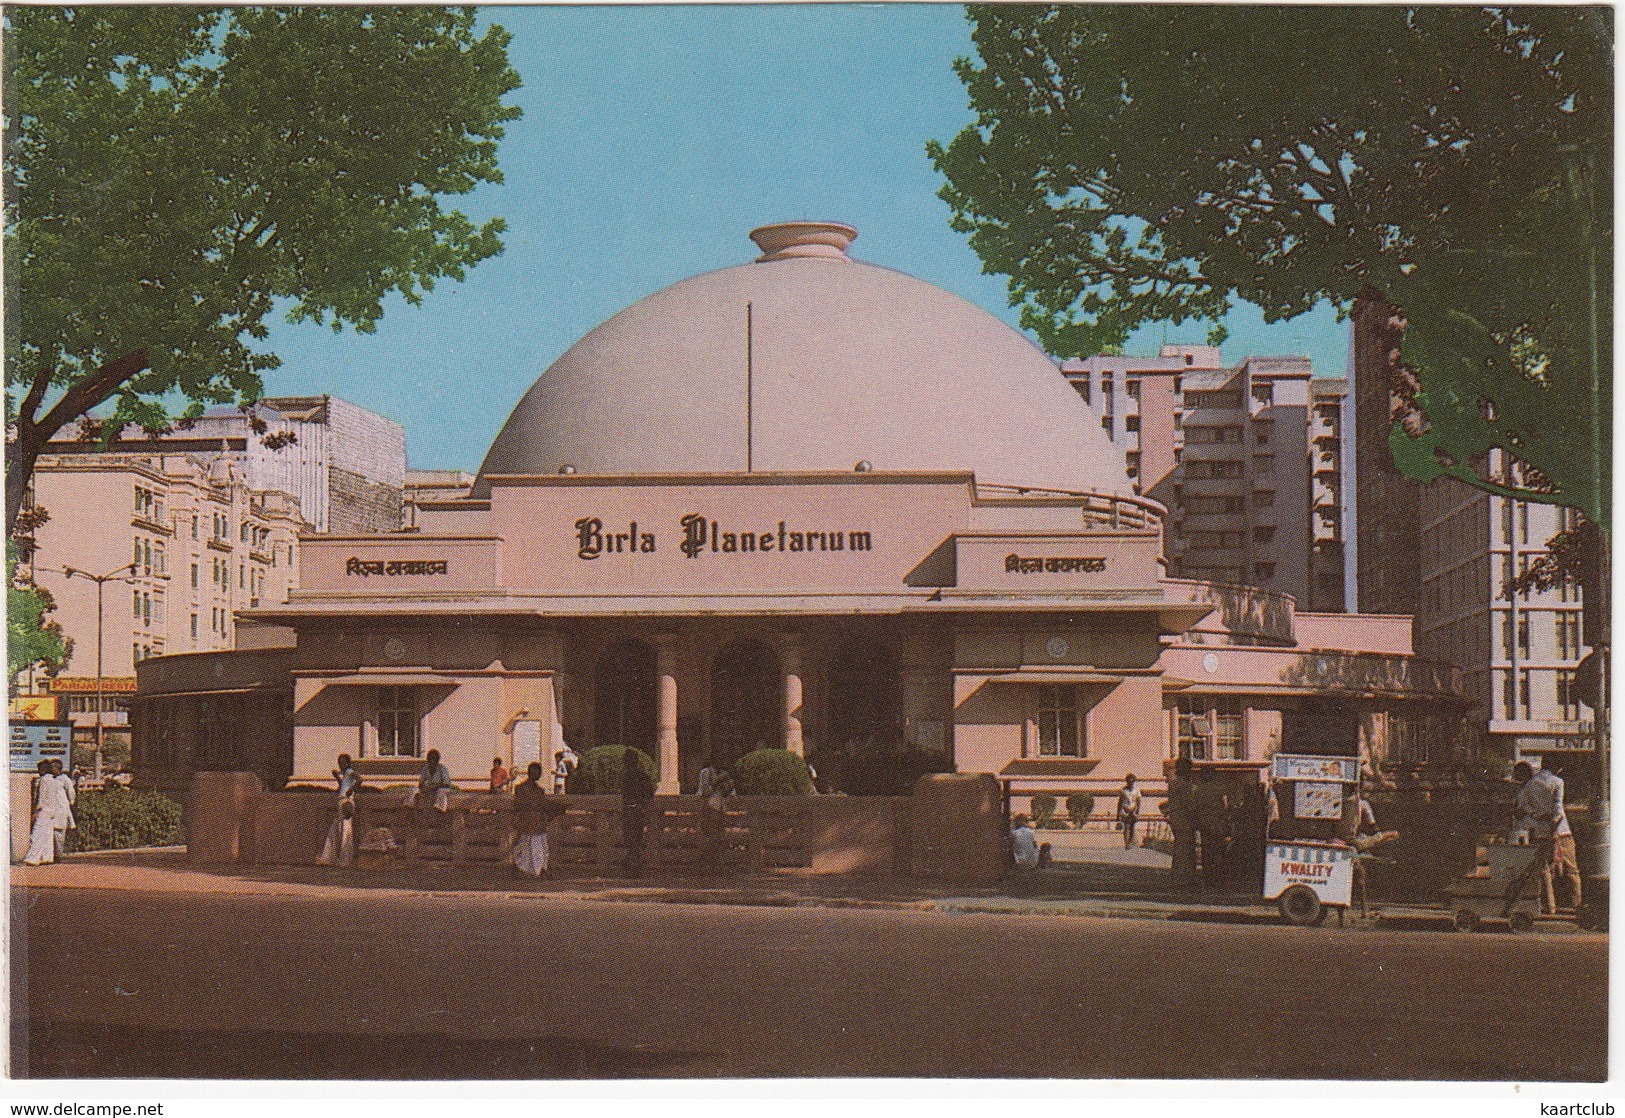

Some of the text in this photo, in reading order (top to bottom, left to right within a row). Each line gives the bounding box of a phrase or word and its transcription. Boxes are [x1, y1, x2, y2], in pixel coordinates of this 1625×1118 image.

[574, 512, 873, 561] Birla Planetarium
[1280, 861, 1334, 877] KWALITY
